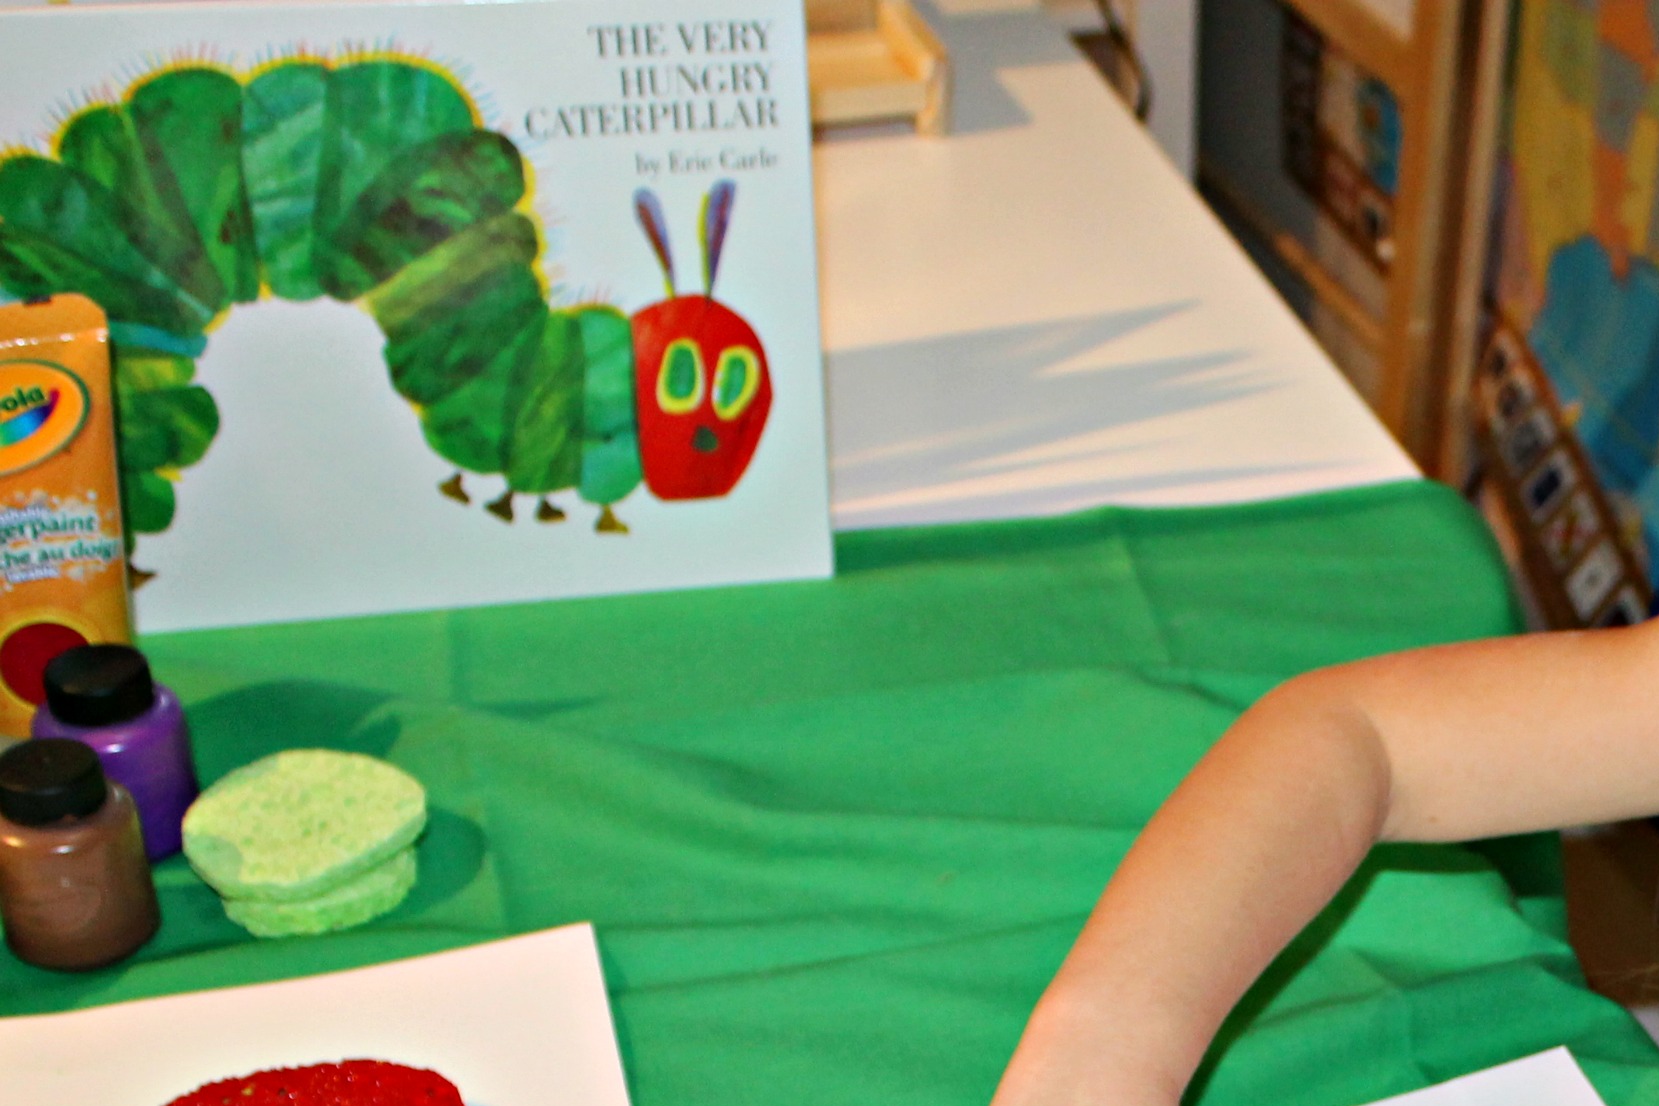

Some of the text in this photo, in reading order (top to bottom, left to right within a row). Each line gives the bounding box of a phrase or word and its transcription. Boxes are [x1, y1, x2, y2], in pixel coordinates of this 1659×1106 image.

[587, 19, 771, 57] THE VERY
[619, 61, 771, 98] HUNGRY
[524, 98, 779, 139] CATERPILLAR
[634, 146, 778, 177] by Eric Carle
